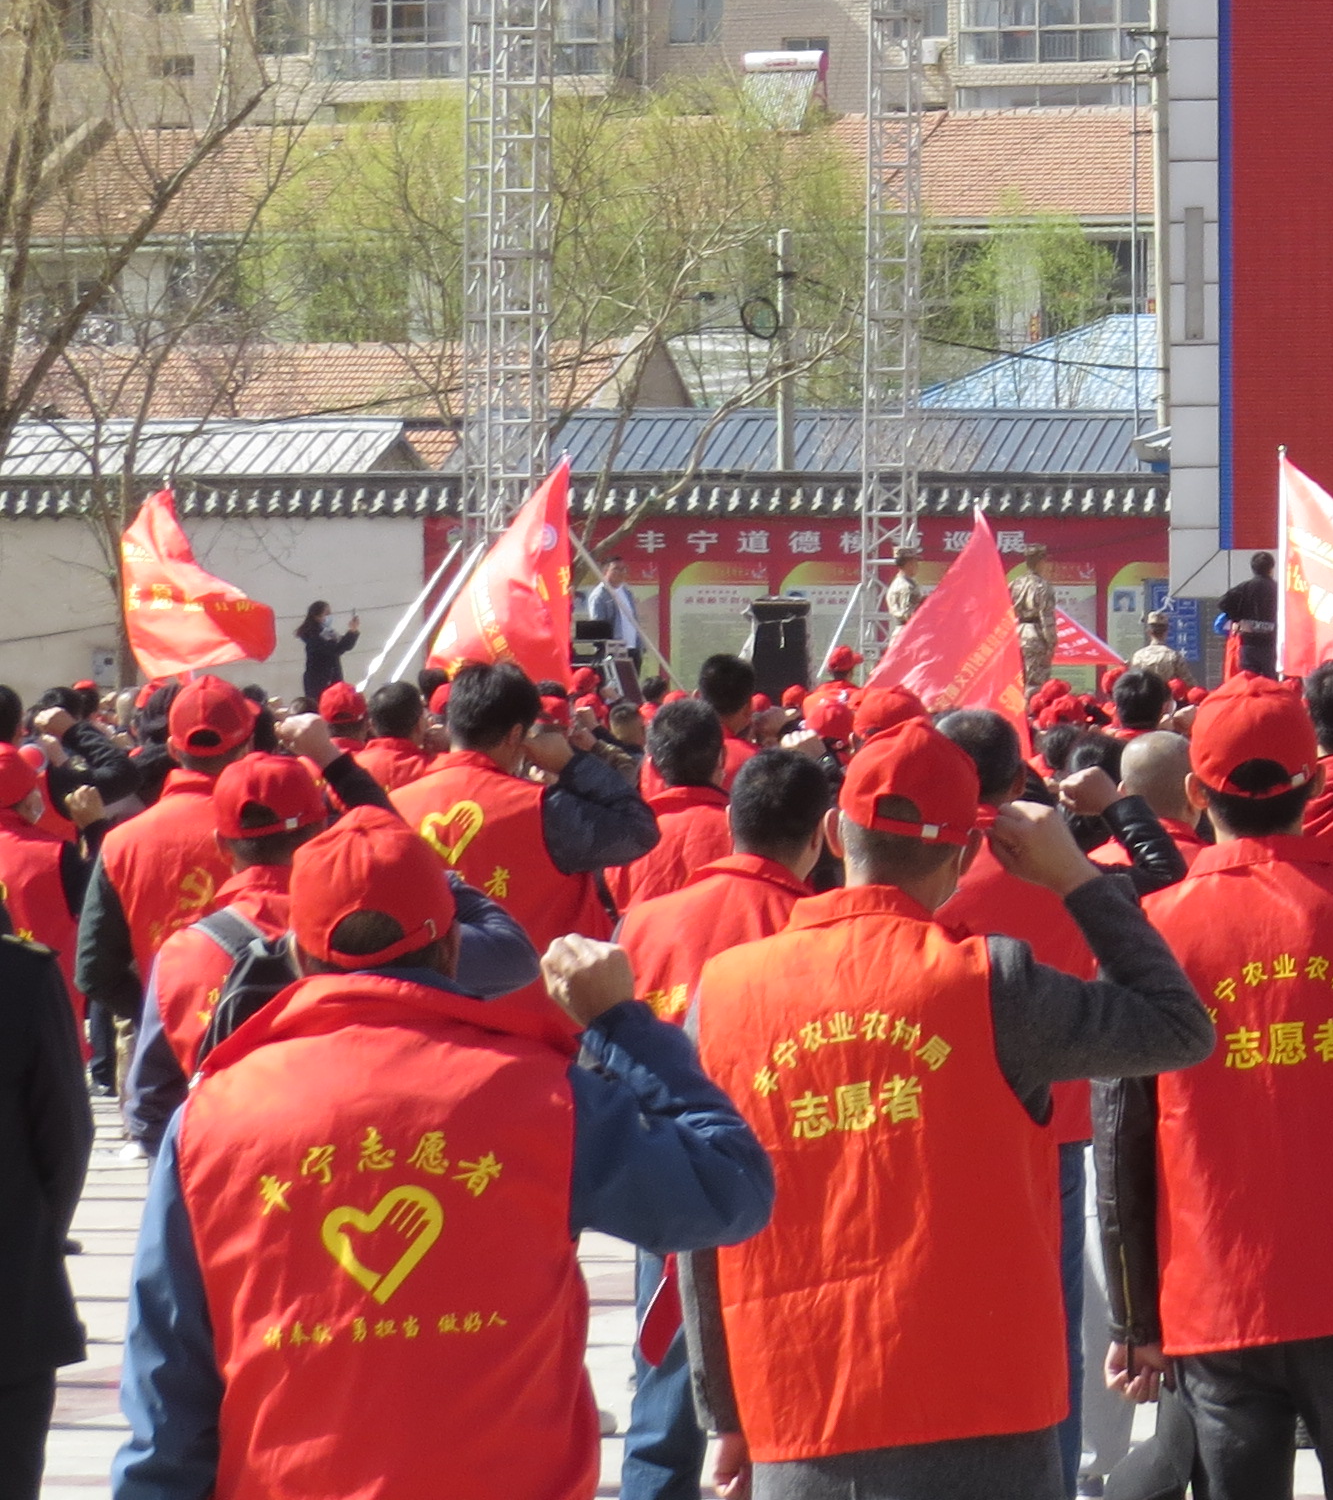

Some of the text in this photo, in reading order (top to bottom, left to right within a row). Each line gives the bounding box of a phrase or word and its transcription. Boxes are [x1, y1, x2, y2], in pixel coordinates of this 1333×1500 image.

[753, 1010, 952, 1098] 丰宁农业农村局
[789, 1074, 923, 1140] 志愿者
[259, 1126, 504, 1216] 丰宁志愿者
